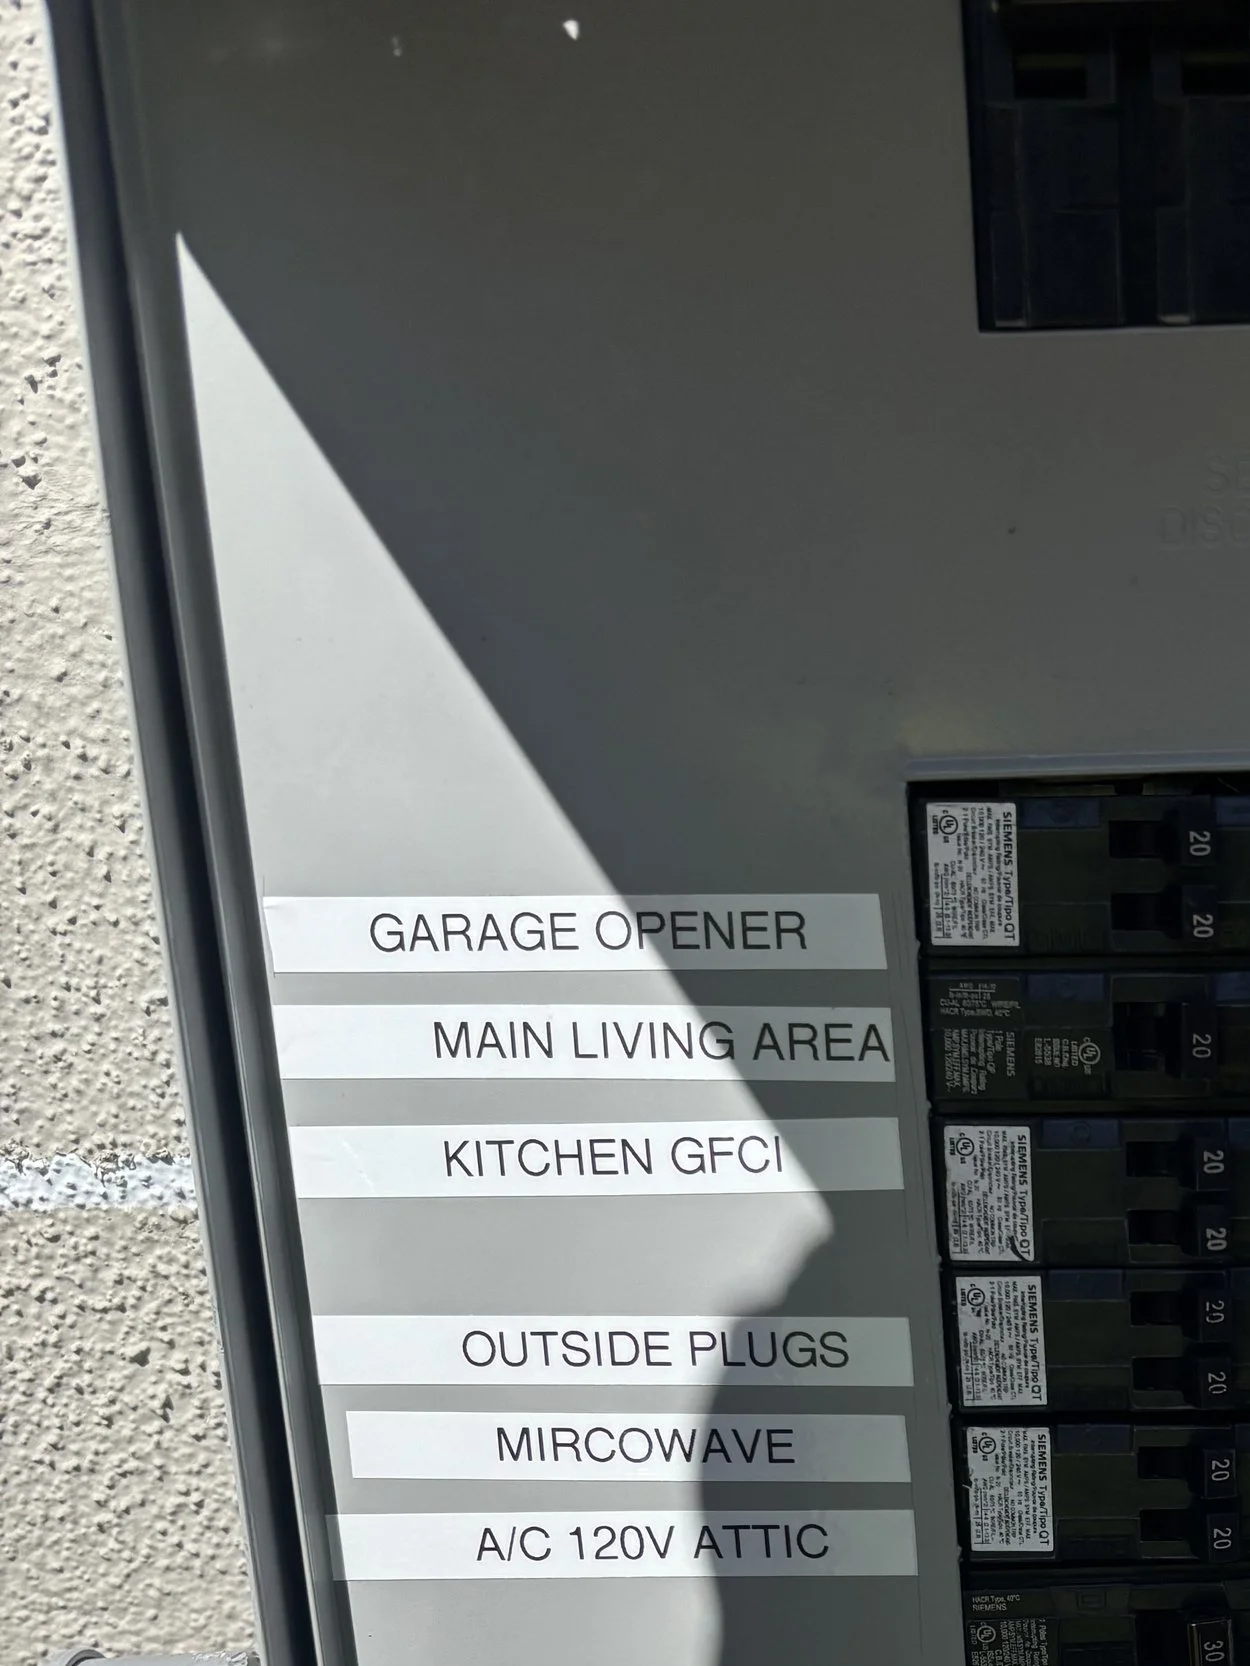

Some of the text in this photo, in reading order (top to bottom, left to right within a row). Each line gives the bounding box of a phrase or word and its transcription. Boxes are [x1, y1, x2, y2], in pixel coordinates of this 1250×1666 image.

[1002, 811, 1013, 866] SIEMENS
[1189, 831, 1211, 856] 20
[370, 911, 806, 952] GARAGE OPENER
[1193, 914, 1214, 937] 20
[434, 1022, 890, 1062] MAIN LIVING AREA
[1192, 1034, 1211, 1058] 20
[444, 1136, 782, 1176] KITCHEN GFCI
[1204, 1150, 1224, 1173] 20
[1206, 1228, 1227, 1250] 20
[1206, 1300, 1224, 1323] 20
[462, 1331, 848, 1368] OUTSIDE PLUGS
[1208, 1372, 1227, 1394] 20
[497, 1427, 794, 1463] MIRCOWAVE
[1212, 1459, 1230, 1481] 20
[477, 1524, 829, 1561] A/C 120V ATTIC
[1214, 1528, 1231, 1549] 20
[1204, 1641, 1225, 1661] 30
